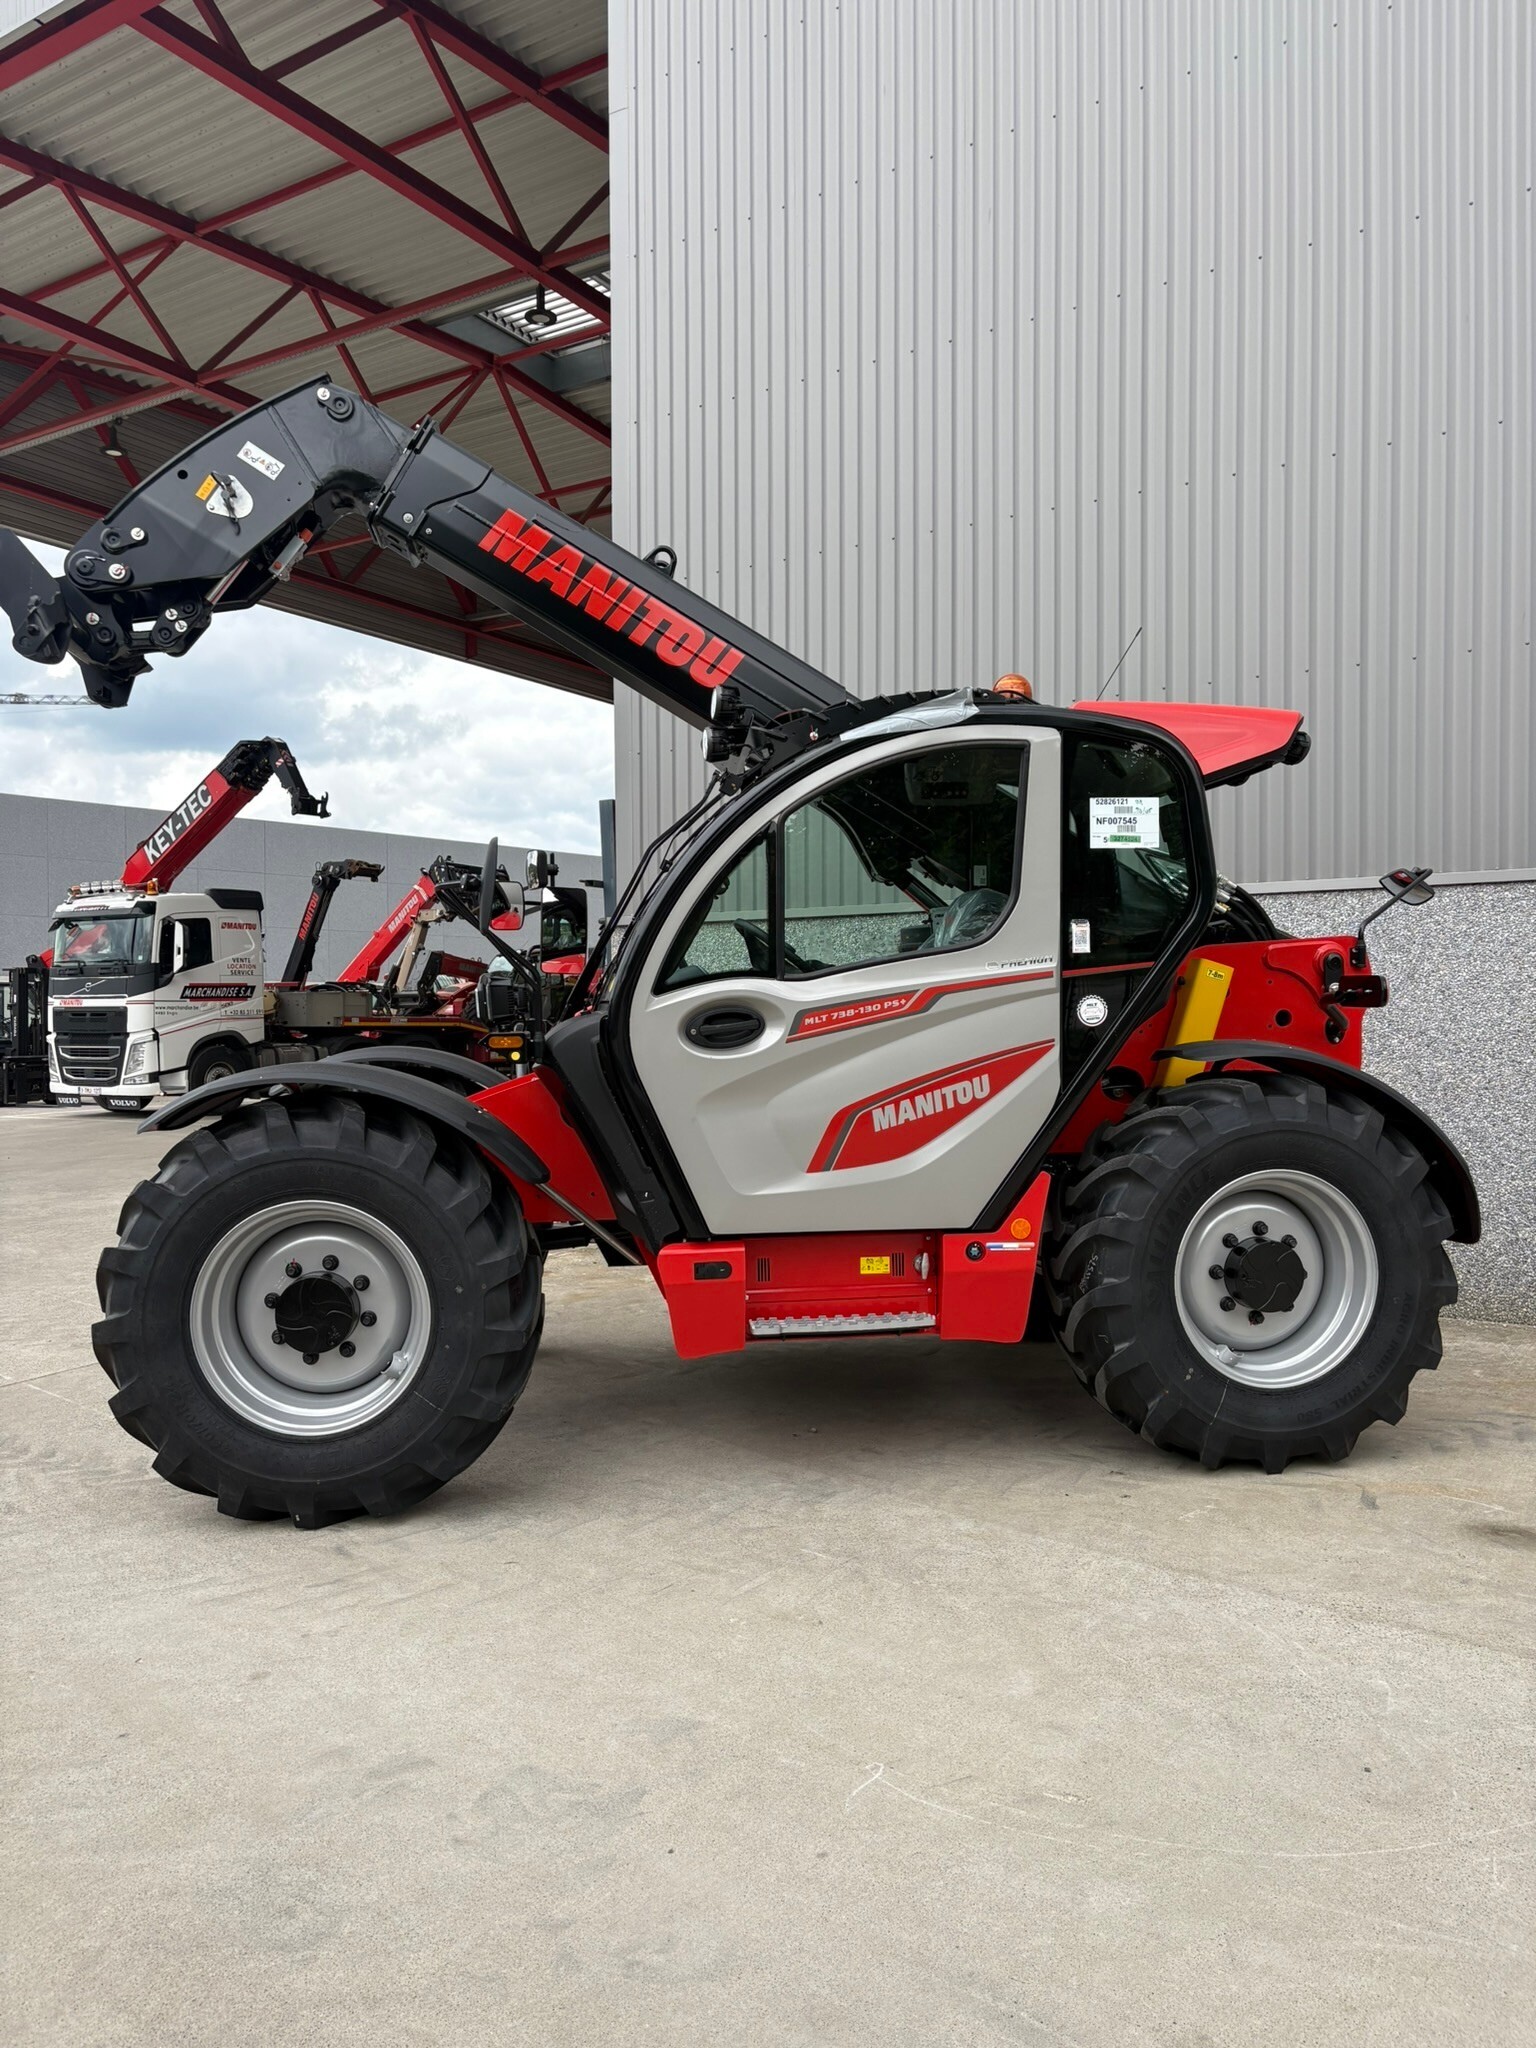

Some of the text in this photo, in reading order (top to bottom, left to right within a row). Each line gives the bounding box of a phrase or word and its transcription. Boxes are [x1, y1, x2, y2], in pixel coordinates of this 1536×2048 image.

[477, 507, 746, 688] MANITOU
[143, 783, 213, 865] KEY-TEC
[1096, 817, 1138, 825] NF007545
[227, 922, 257, 930] MANITOU
[298, 892, 319, 940] MANITOU
[387, 894, 419, 934] MANITOU
[183, 987, 252, 997] MARCHANDISE S.A.
[804, 997, 908, 1026] MLT 738-130 PS+
[109, 1099, 138, 1107] VOLVO
[871, 1073, 991, 1134] MANITOU
